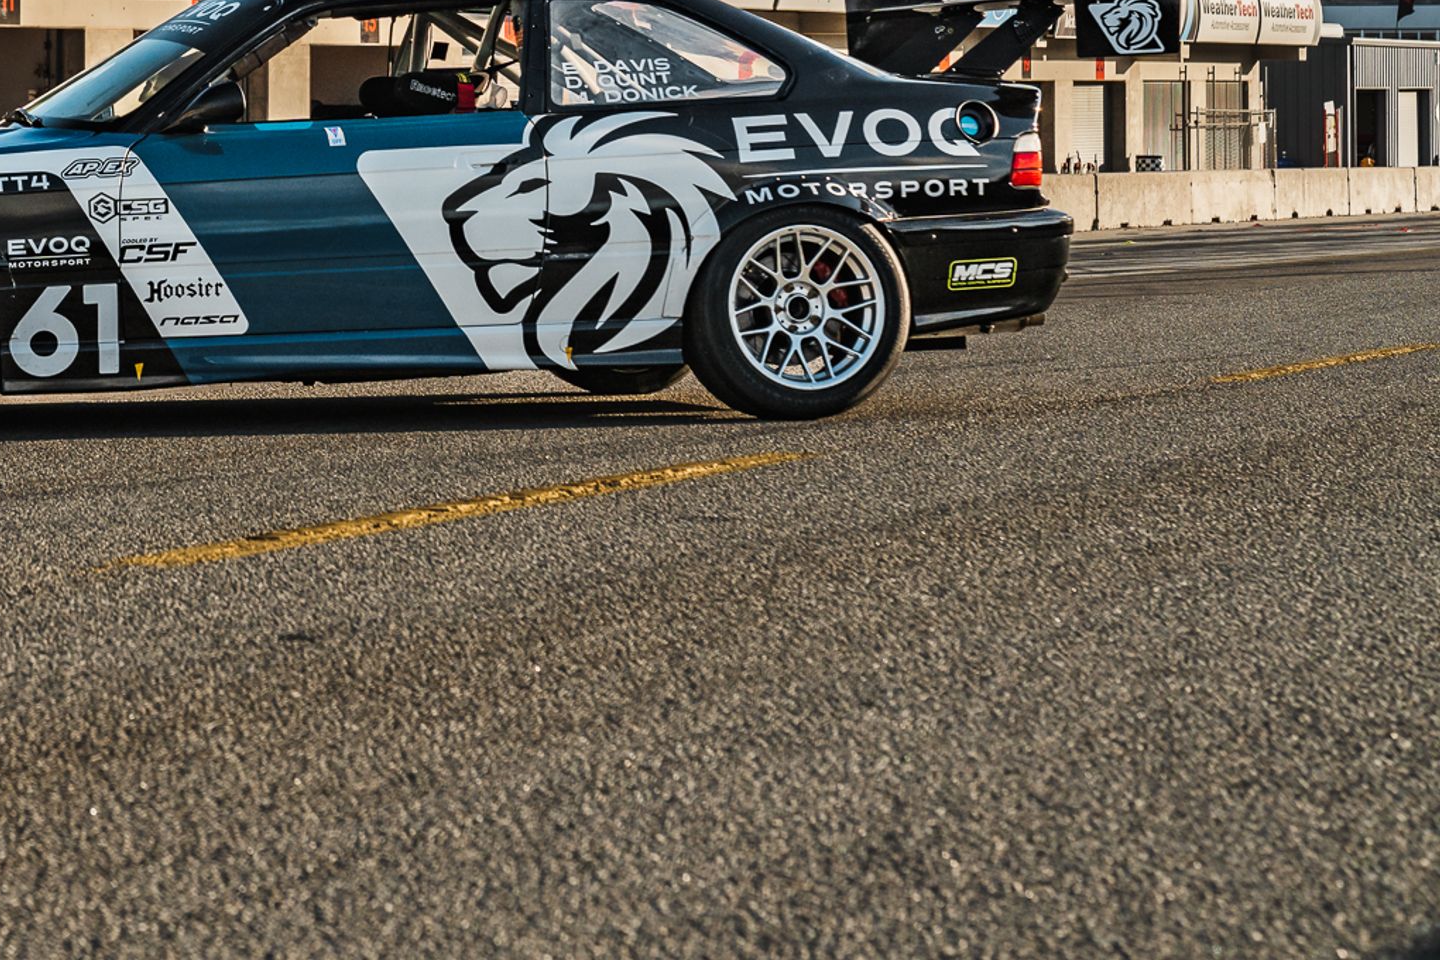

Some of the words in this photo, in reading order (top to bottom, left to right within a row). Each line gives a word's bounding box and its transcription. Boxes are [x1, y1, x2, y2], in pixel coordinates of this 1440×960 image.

[1262, 1, 1314, 19] WeatherTech
[593, 57, 670, 73] DAVIS
[565, 76, 588, 89] D.
[598, 71, 671, 88] QUINT
[605, 85, 698, 103] DONICK
[731, 107, 982, 163] EVOQ
[63, 158, 138, 178] APEX
[744, 178, 990, 205] MOTORSPORT
[118, 199, 167, 215] CSG
[7, 236, 91, 255] EVOQ
[119, 242, 197, 264] CSF
[8, 258, 91, 269] MOTORSPORT
[952, 262, 1013, 281] MCS
[144, 277, 223, 303] Hoosier
[9, 283, 120, 378] 61
